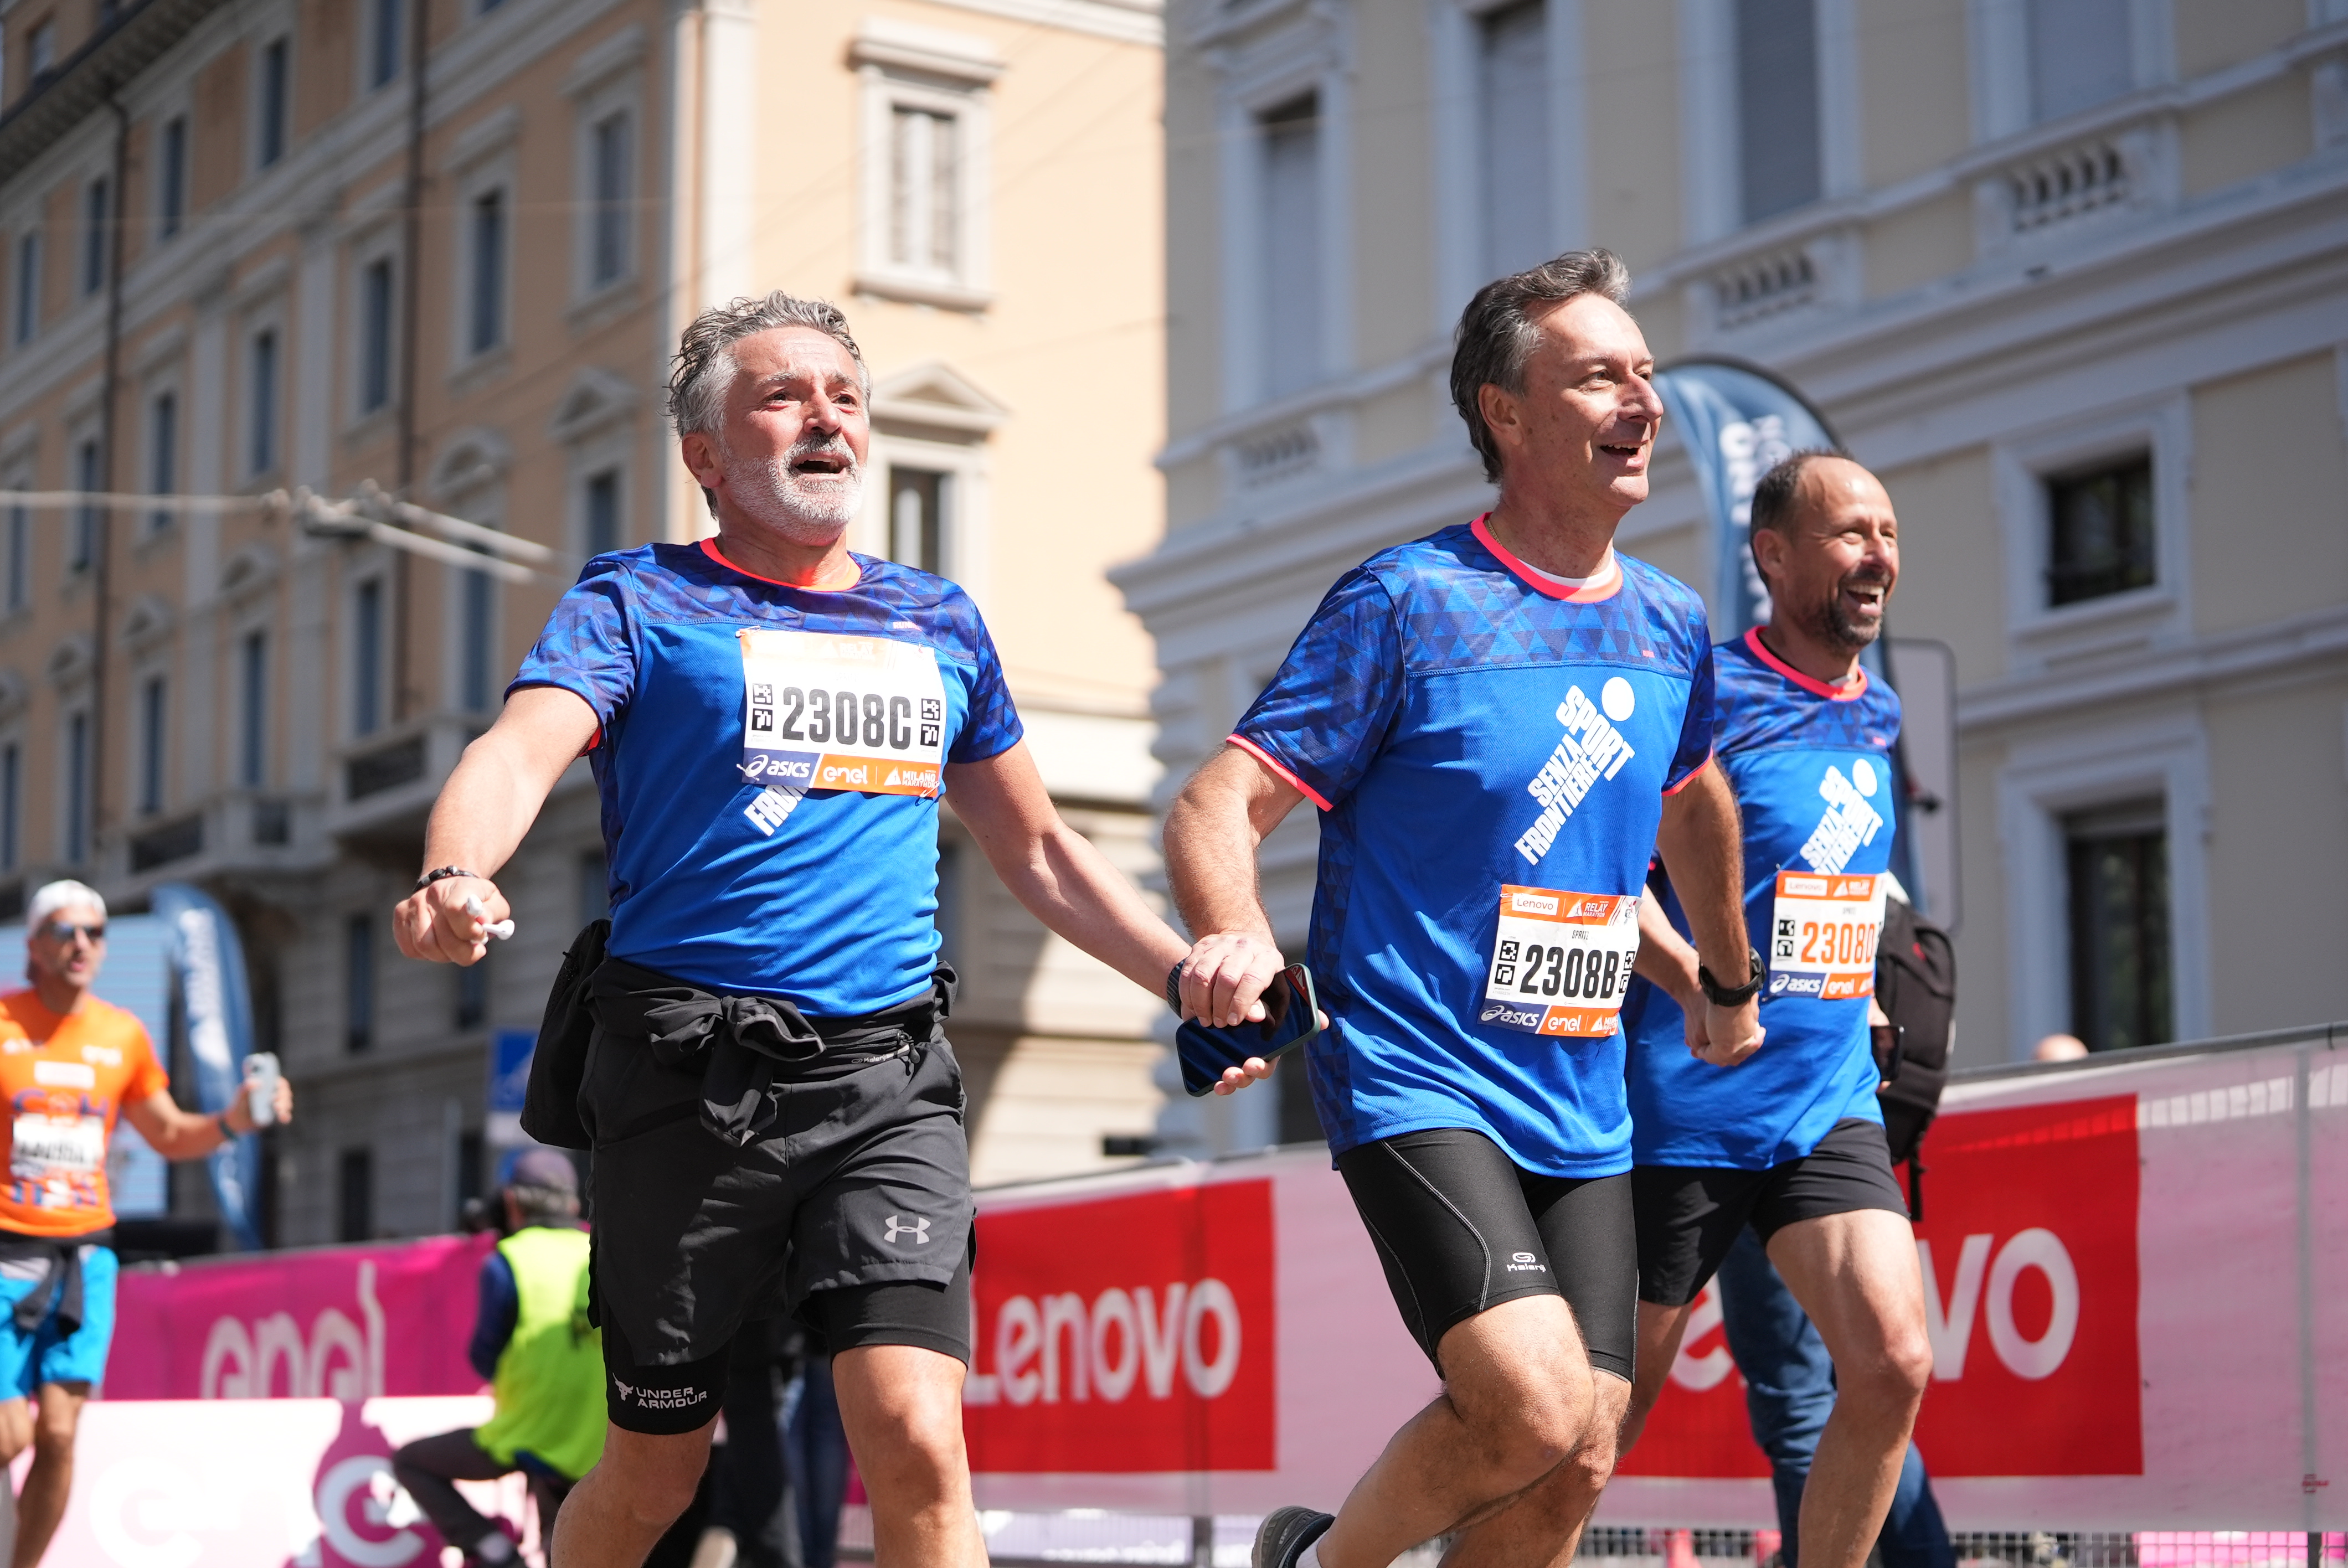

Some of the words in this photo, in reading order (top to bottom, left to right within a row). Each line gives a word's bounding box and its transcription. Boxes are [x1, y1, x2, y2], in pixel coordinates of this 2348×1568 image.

[782, 687, 911, 750] 2308C
[1556, 685, 1635, 781] SPORT
[766, 760, 810, 778] asics
[823, 765, 868, 785] enel
[903, 770, 936, 782] MILANO
[1527, 733, 1584, 807] SENZA
[902, 779, 936, 788] MARATHON
[1514, 751, 1600, 865] FRONTIERE
[1819, 765, 1883, 847] SPORT
[1517, 898, 1553, 910] Lenovo
[1584, 902, 1608, 912] RELAY
[1572, 930, 1589, 940] SPRITZ
[1519, 945, 1619, 999] 2308B
[1786, 977, 1821, 993] asics
[1500, 1010, 1539, 1027] asics
[1548, 1015, 1582, 1031] enel
[964, 1277, 1243, 1407] Lenovo
[636, 1386, 694, 1400] UNDER
[637, 1391, 708, 1410] ARMOUR
